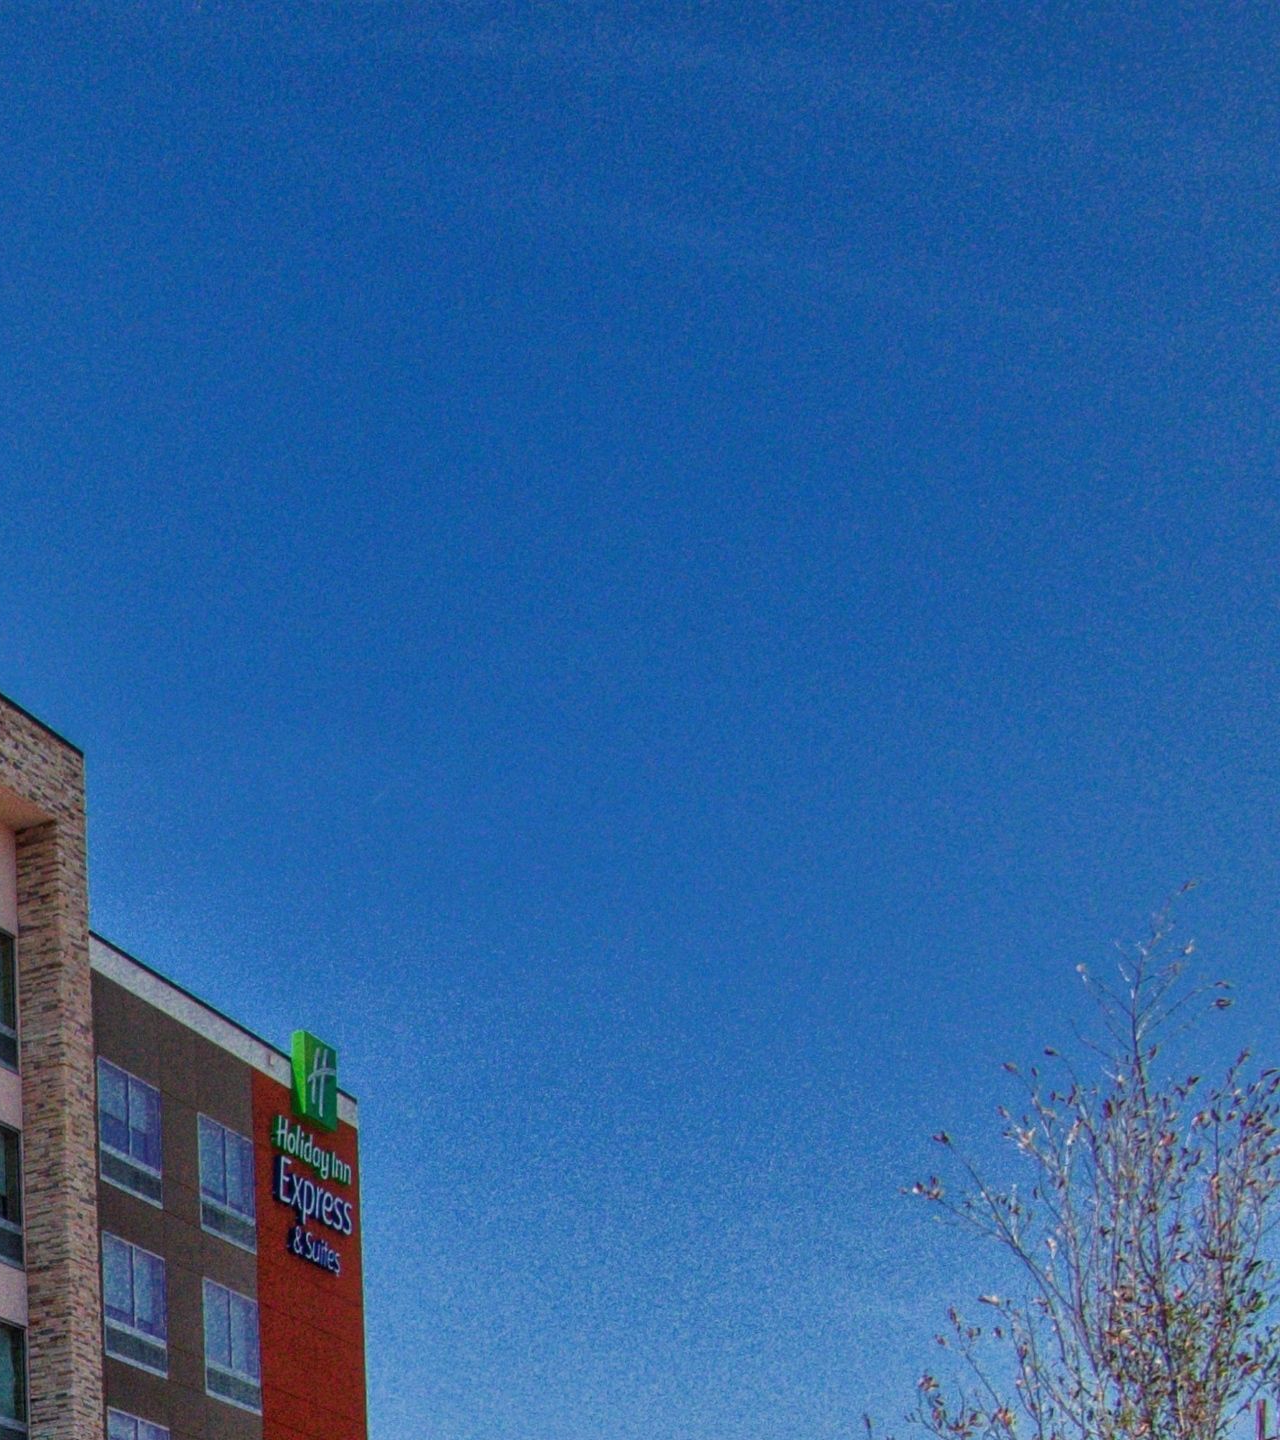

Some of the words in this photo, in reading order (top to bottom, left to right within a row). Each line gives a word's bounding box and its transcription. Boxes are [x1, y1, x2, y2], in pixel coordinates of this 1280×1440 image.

[277, 1115, 330, 1180] Holiday
[331, 1151, 352, 1185] Inn
[279, 1156, 352, 1235] Express
[293, 1225, 303, 1254] &
[305, 1231, 340, 1275] Suites
